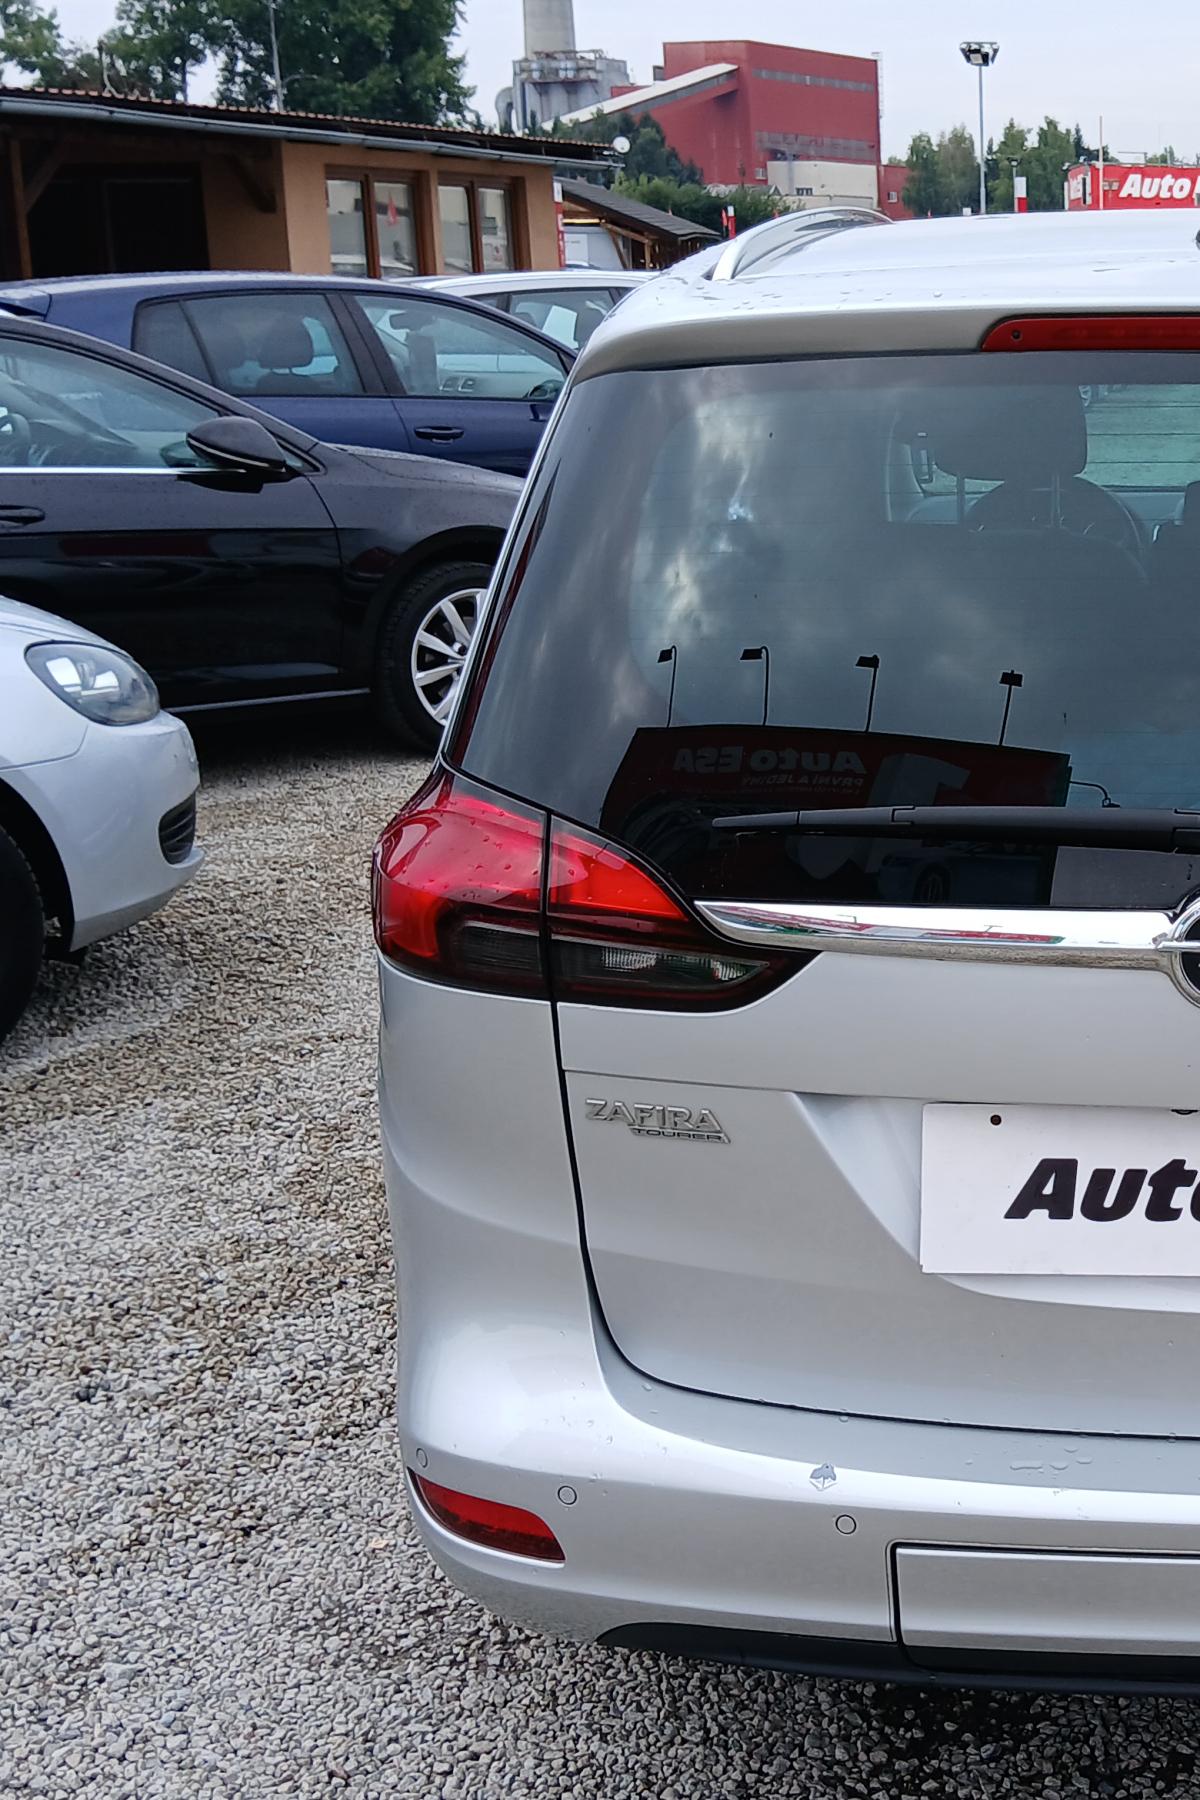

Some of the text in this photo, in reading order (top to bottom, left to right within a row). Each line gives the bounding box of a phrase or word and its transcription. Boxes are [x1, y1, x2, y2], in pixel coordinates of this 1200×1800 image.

[1119, 173, 1192, 200] Auto
[585, 1098, 723, 1132] ZAFIRA
[632, 1127, 727, 1143] TOURER
